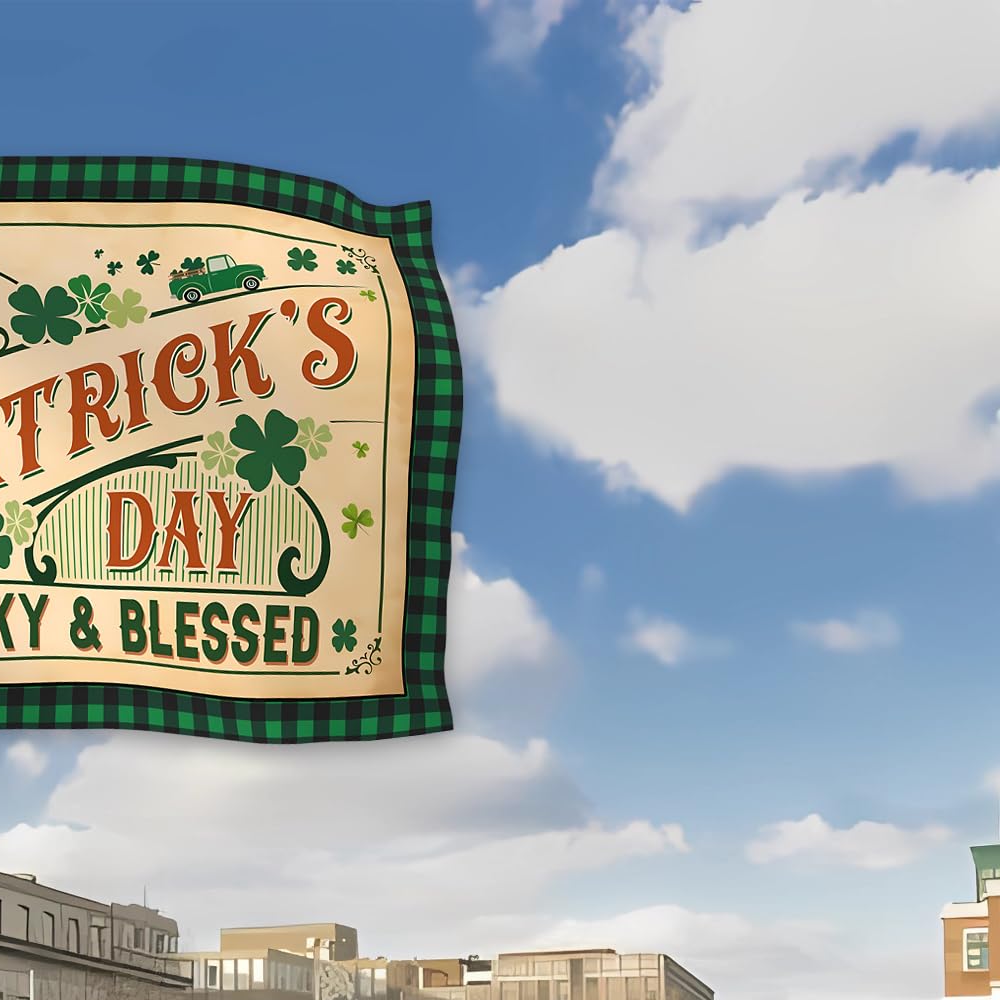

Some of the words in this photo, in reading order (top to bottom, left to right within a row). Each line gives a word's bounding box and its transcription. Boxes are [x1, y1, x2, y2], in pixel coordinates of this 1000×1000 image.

[106, 490, 255, 575] DAY
[69, 595, 102, 652] &
[120, 598, 321, 665] BLESSED
